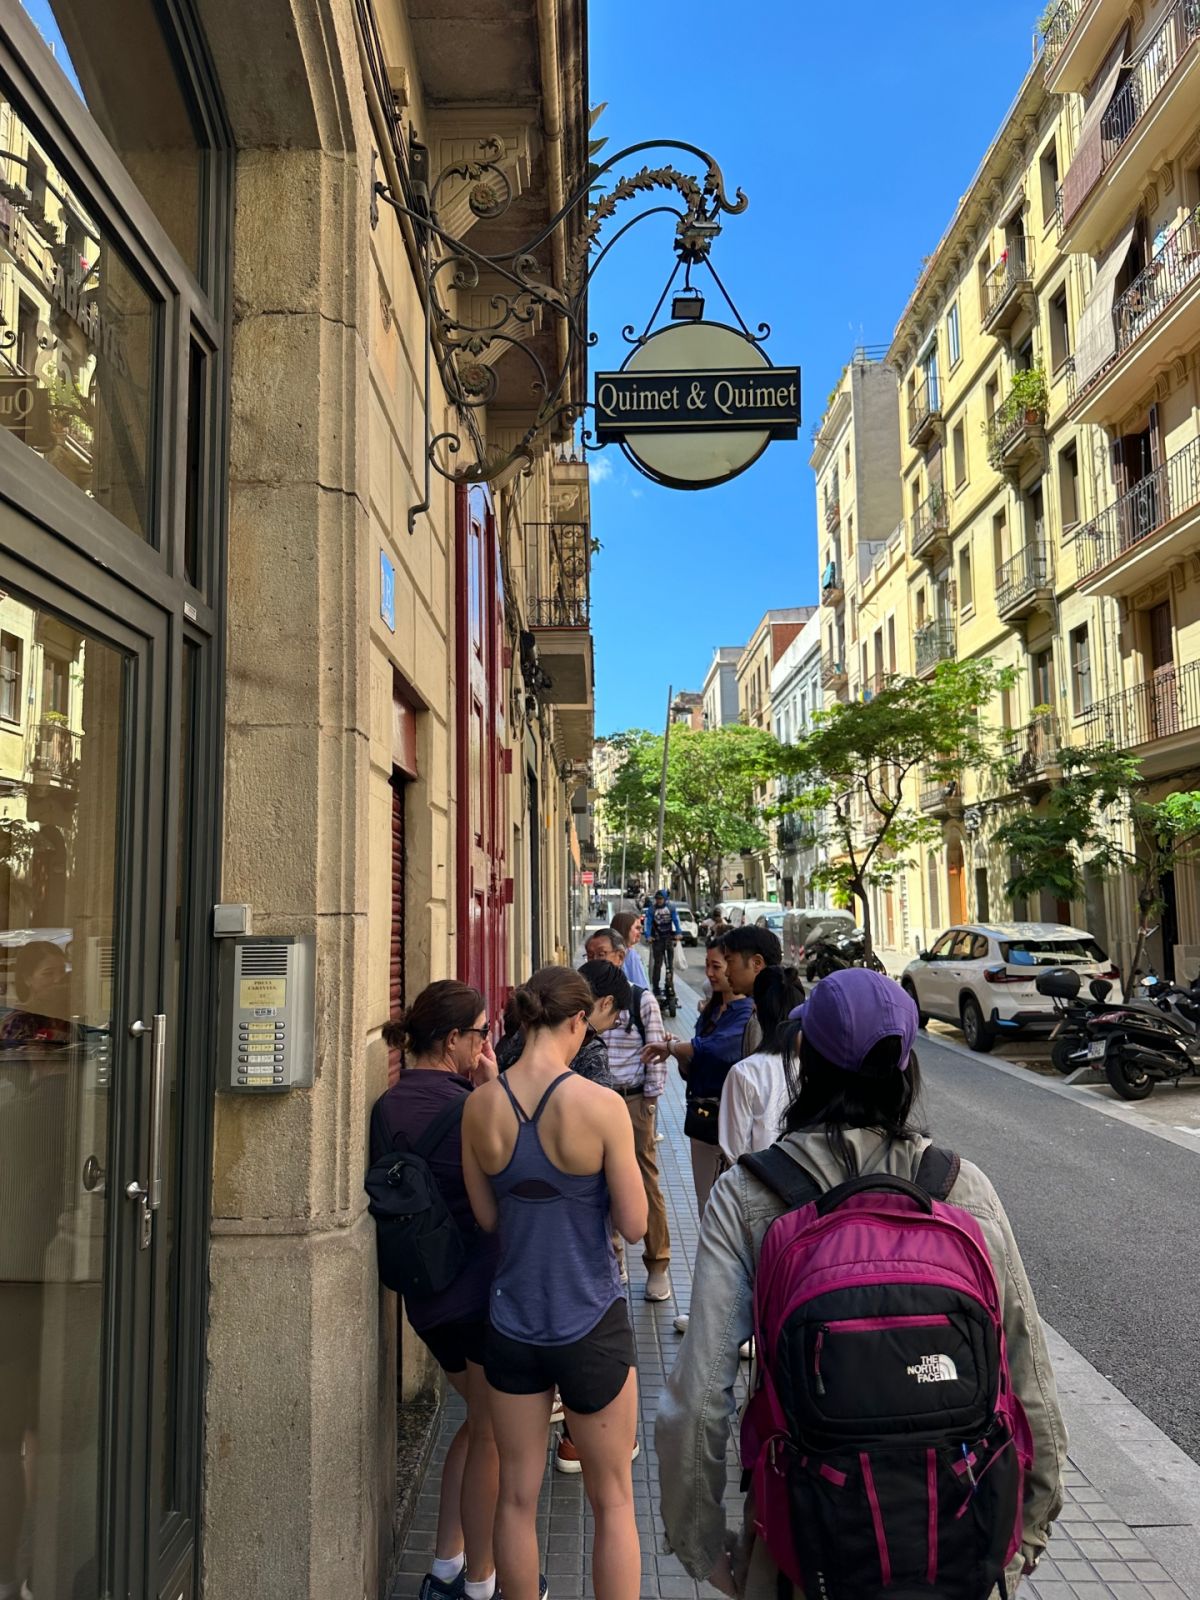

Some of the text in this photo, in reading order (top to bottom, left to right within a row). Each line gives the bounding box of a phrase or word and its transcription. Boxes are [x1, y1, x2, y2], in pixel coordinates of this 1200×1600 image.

[598, 380, 797, 417] Quimet & Quimet
[920, 1355, 939, 1365] THE
[907, 1364, 939, 1375] NORTH
[917, 1373, 941, 1383] FACE
